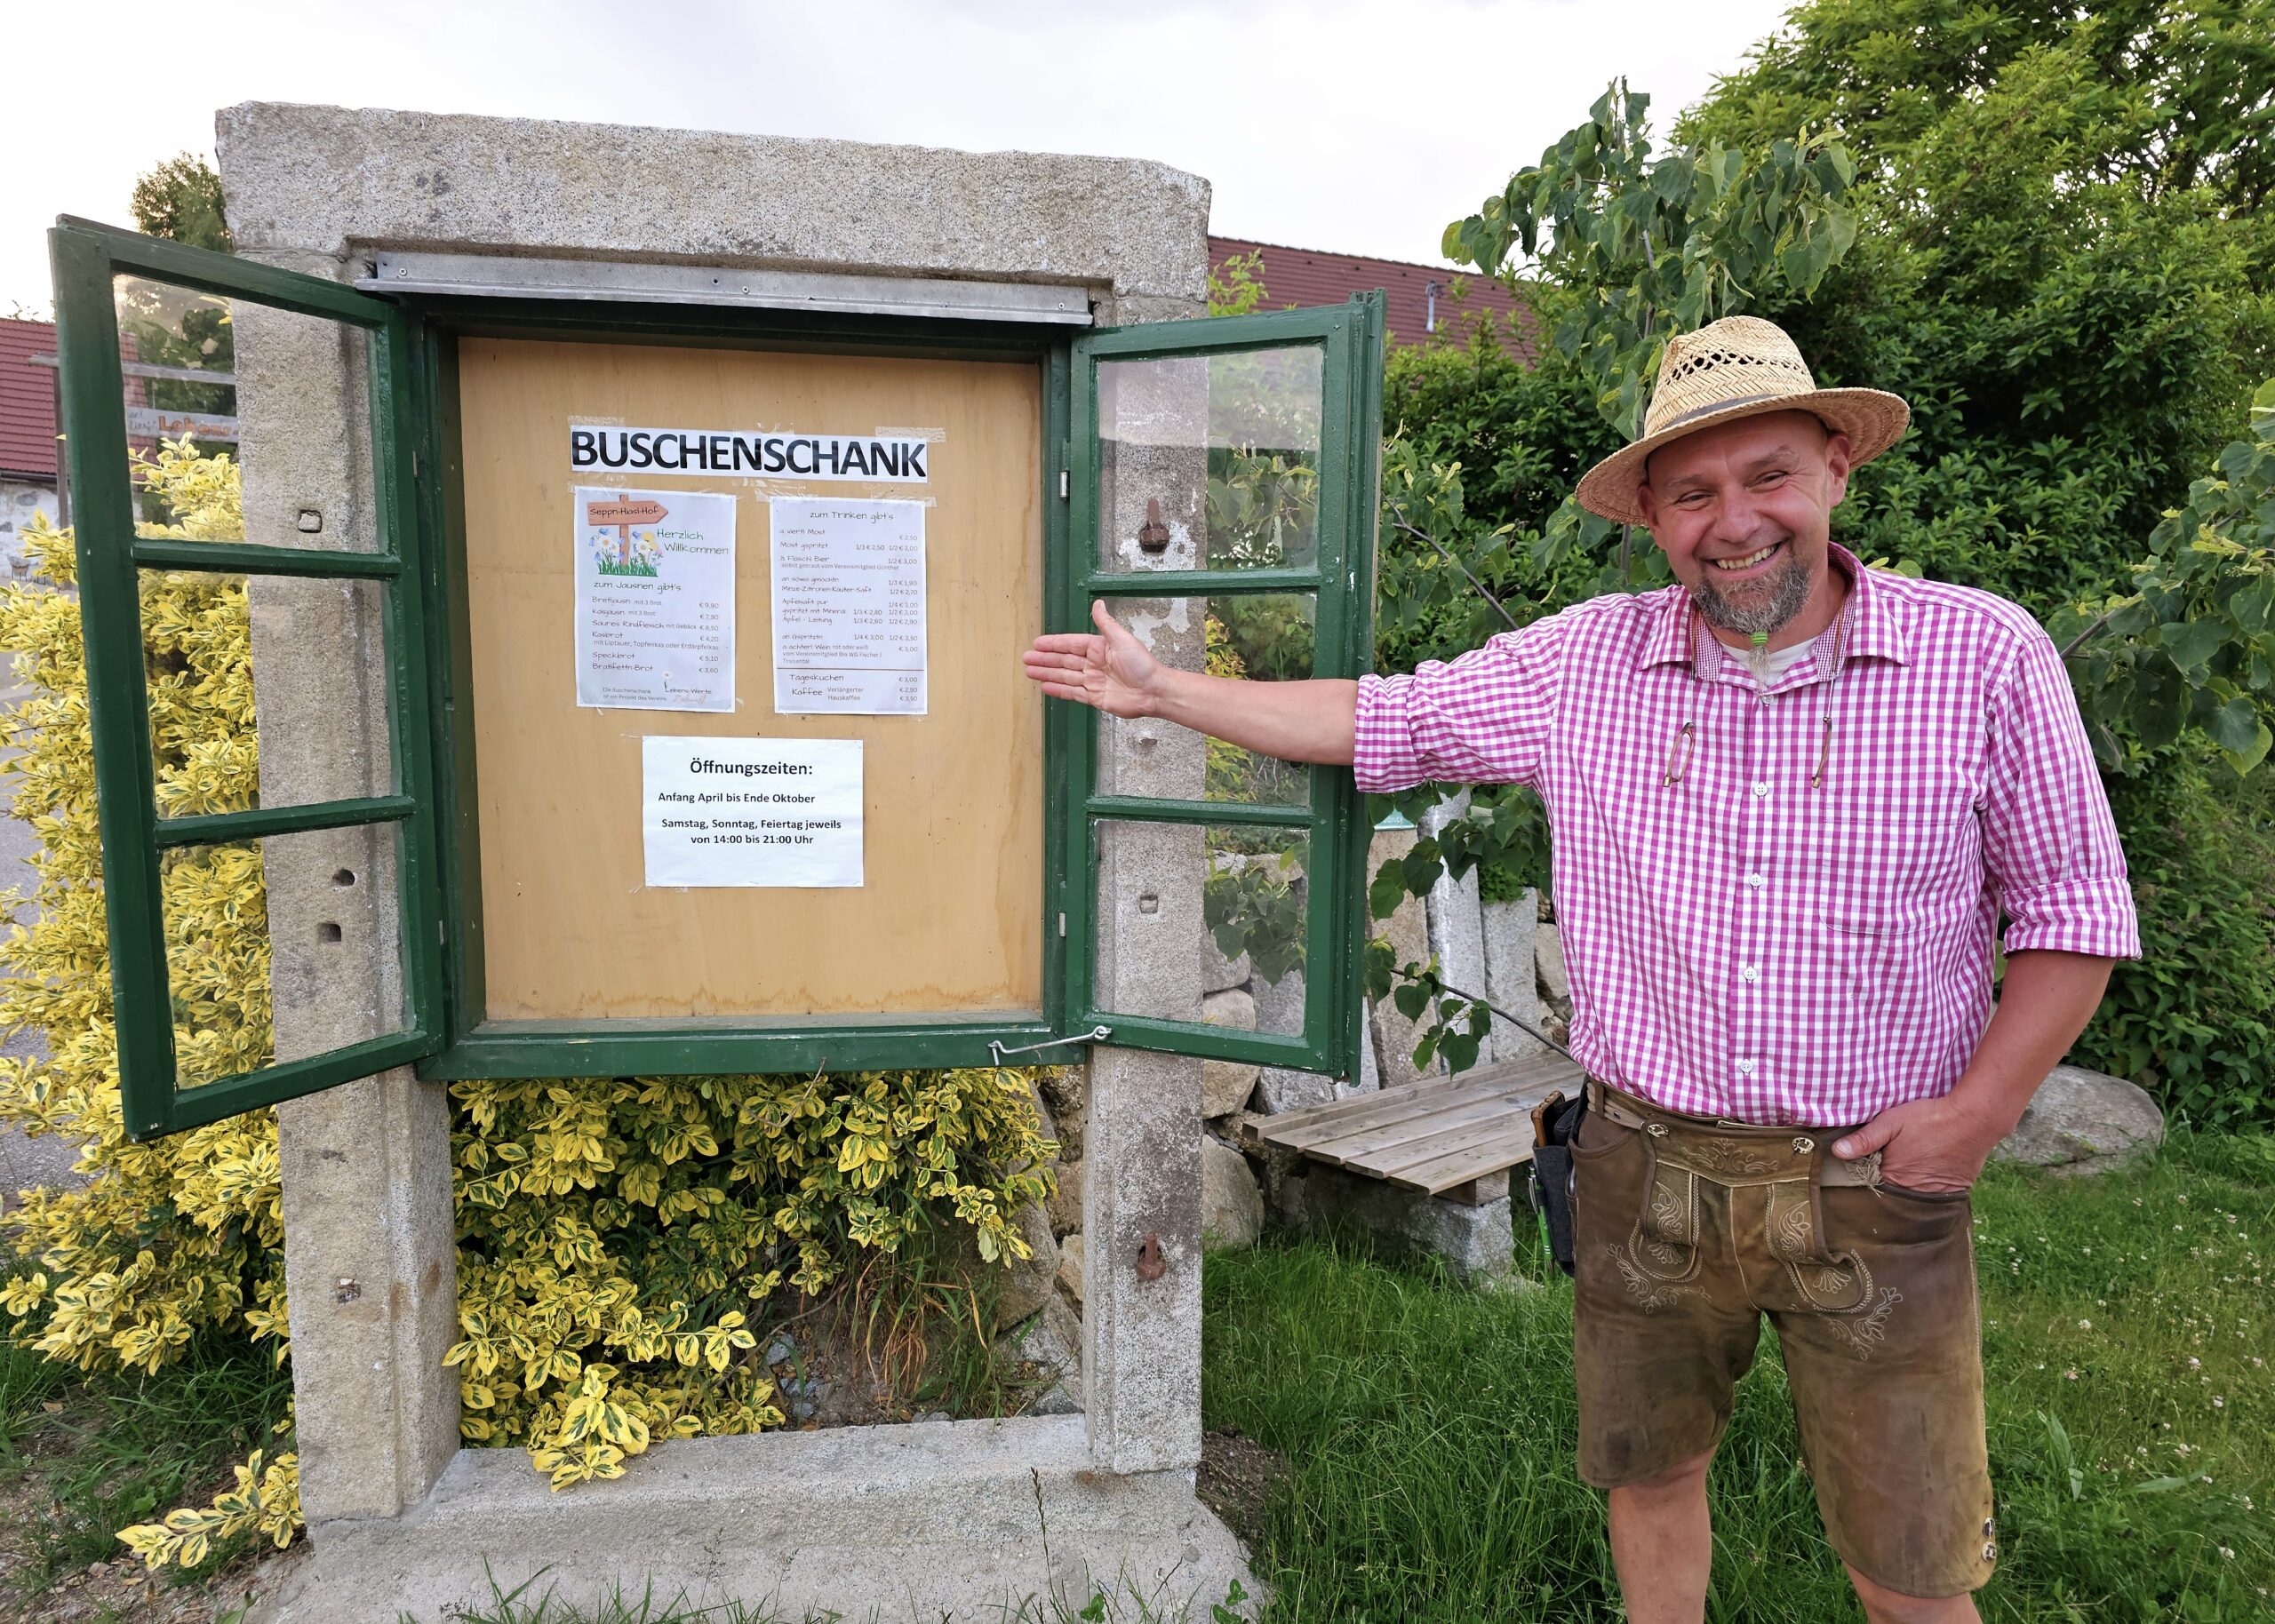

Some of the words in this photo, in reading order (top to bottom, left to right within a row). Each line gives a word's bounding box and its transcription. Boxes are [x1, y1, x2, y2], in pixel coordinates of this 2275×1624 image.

[571, 431, 926, 477] BUSCHENSCHANK
[831, 511, 867, 520] Trinken
[657, 529, 704, 540] Herzlich
[664, 542, 729, 554] Willkommen
[790, 674, 844, 685] Tageskuchen
[690, 758, 812, 777] Öffnungszeiten:
[659, 792, 695, 804] Anfang
[698, 792, 722, 804] April
[726, 793, 740, 802] bis
[744, 793, 770, 803] Ende
[772, 793, 815, 803] Oktober
[661, 819, 708, 830] Samstag,
[712, 819, 757, 830] Sonntag,
[761, 820, 802, 831] Feiertag
[805, 820, 842, 830] jeweils
[714, 835, 742, 844] 14:00
[746, 835, 760, 844] bis
[763, 835, 792, 844] 21:00
[794, 835, 813, 844] Uhr
